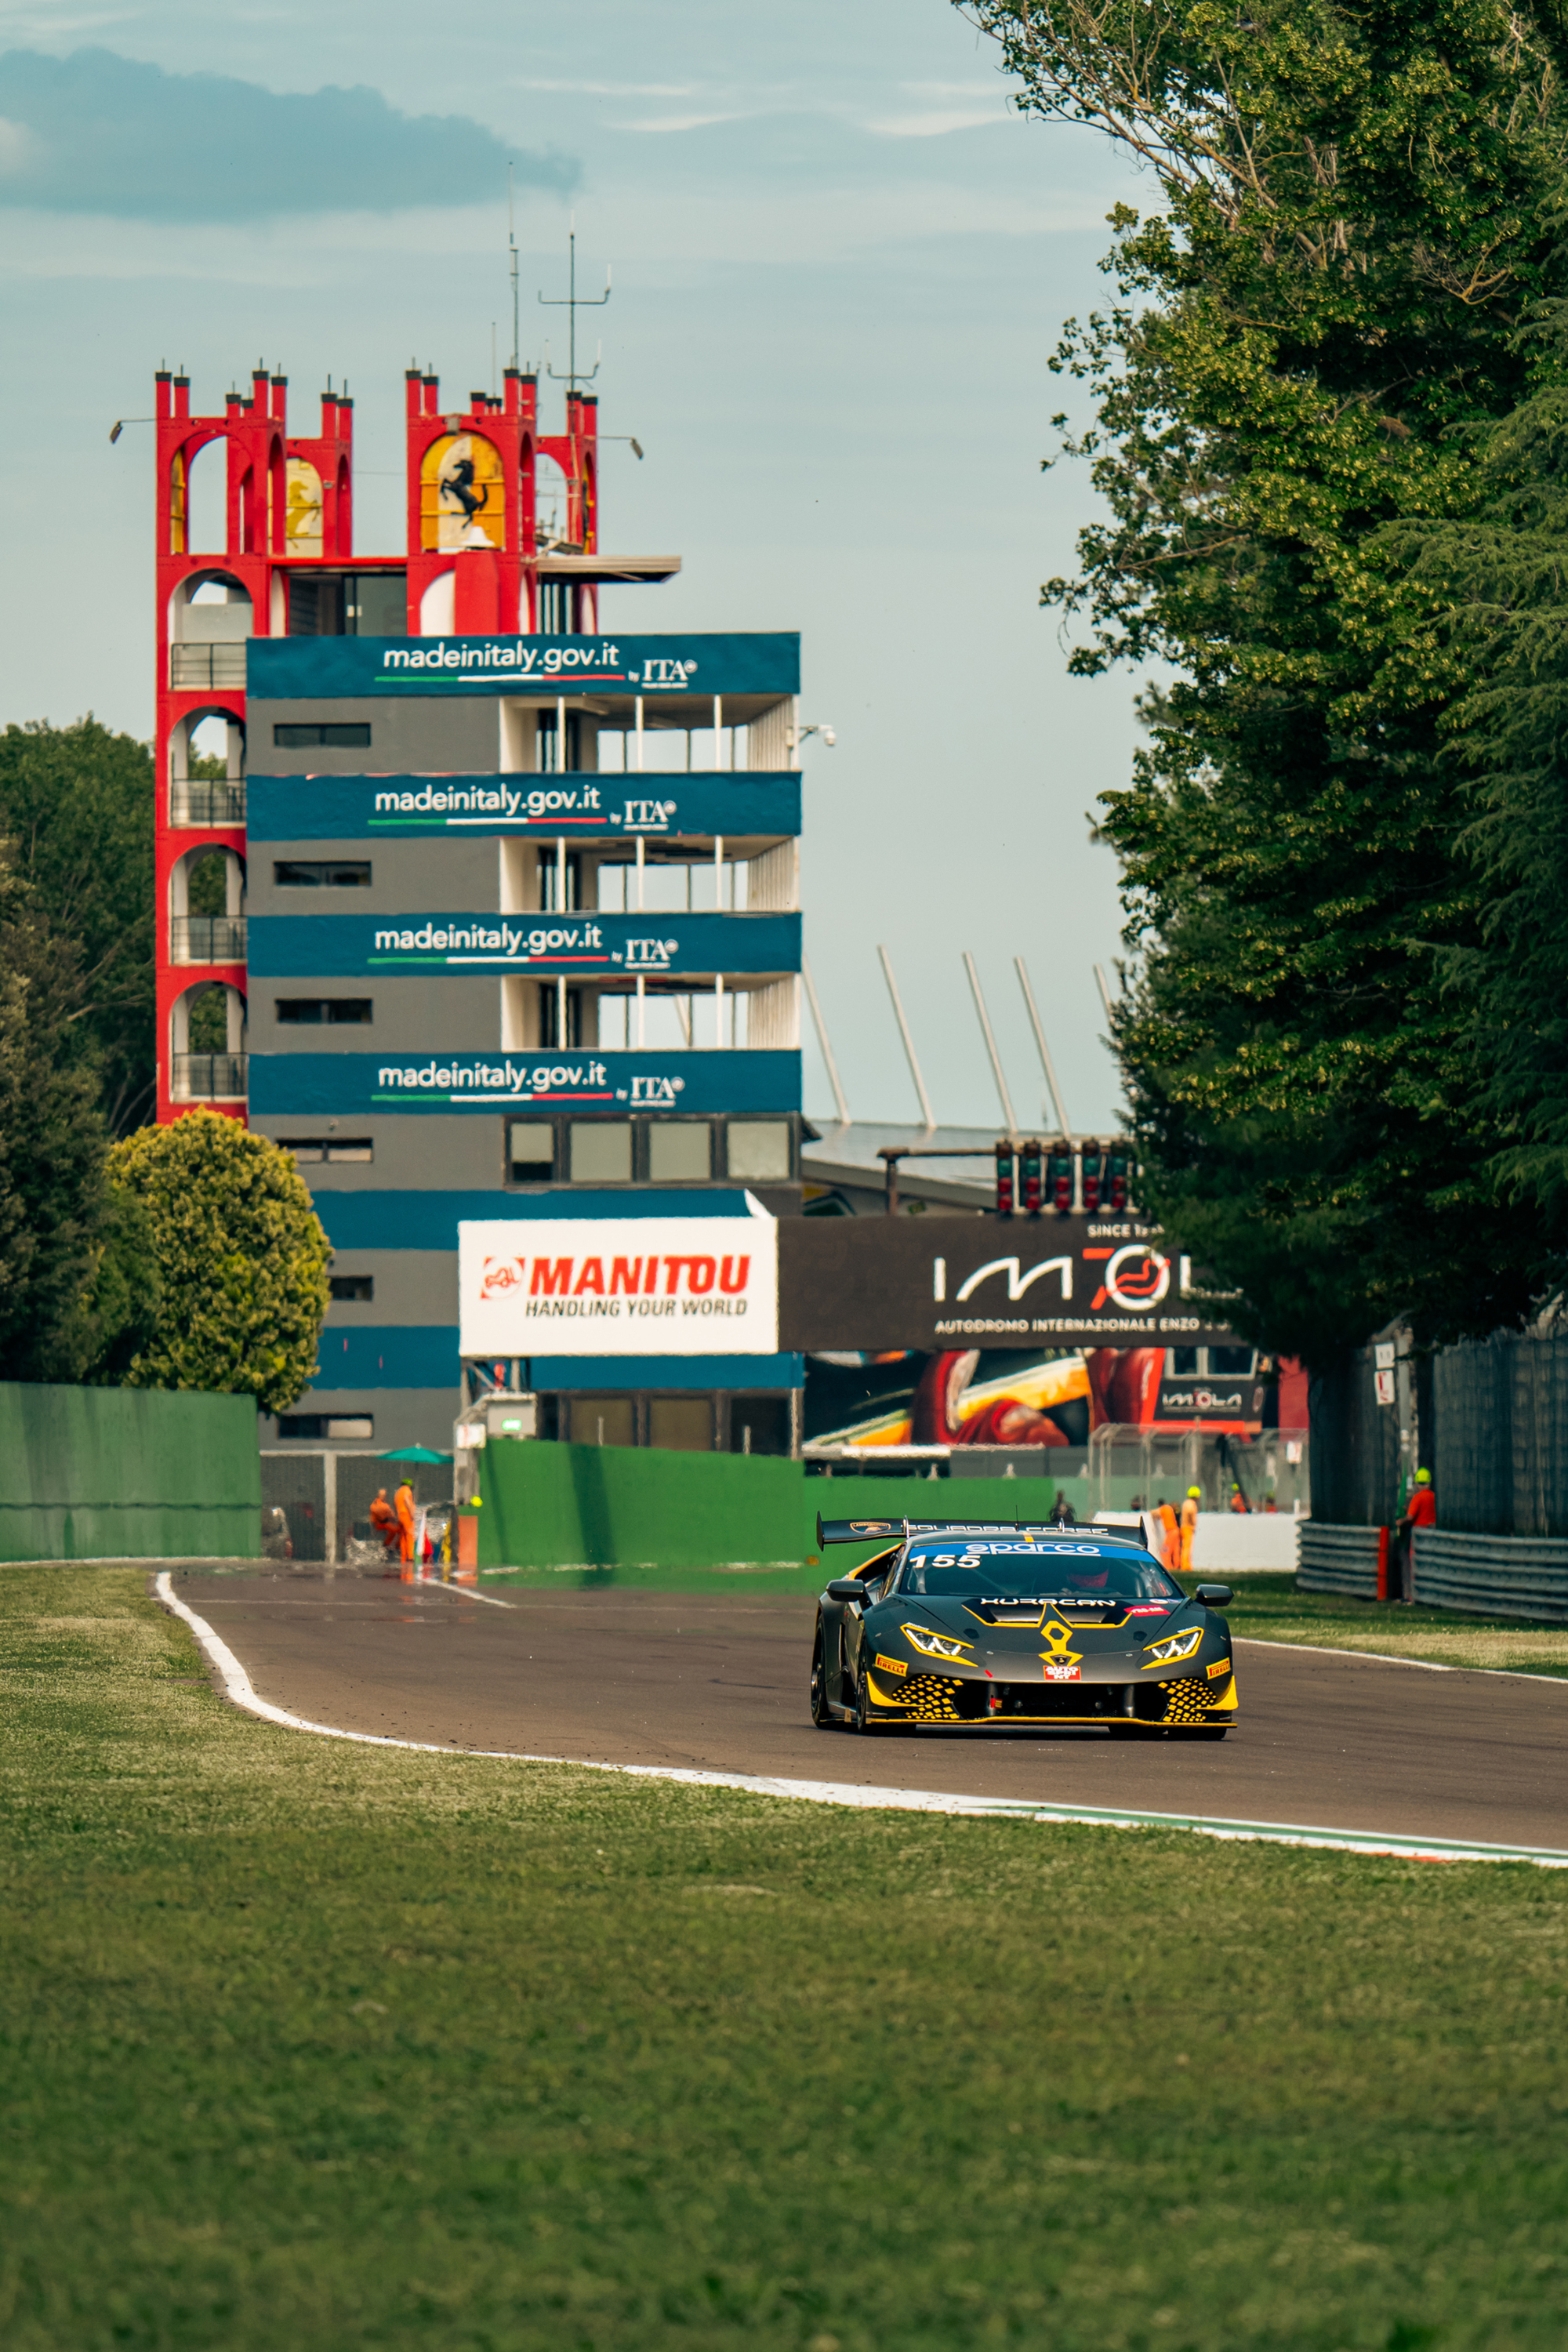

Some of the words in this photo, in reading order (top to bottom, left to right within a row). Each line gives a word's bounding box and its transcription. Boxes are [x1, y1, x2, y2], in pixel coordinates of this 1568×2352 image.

[383, 640, 619, 673] madeinitaly.gov.it
[375, 783, 601, 816] madeinitaly.gov.it
[375, 922, 602, 955] madeinitaly.gov.it
[378, 1060, 606, 1093] madeinitaly.gov.it
[1087, 1223, 1131, 1238] SINCE
[528, 1254, 751, 1295] MANITOU
[525, 1298, 620, 1317] HANDLING
[626, 1298, 677, 1317] YOUR
[681, 1298, 748, 1316] WORLD
[935, 1319, 1029, 1334] AUTODROMO
[1032, 1319, 1156, 1333] INTERNAZIONALE
[1160, 1317, 1200, 1331] ENZO
[965, 1542, 1100, 1555] sparco
[909, 1555, 980, 1568] 155
[877, 1657, 905, 1673] PIRELLI
[1209, 1661, 1229, 1676] PIRELLI
